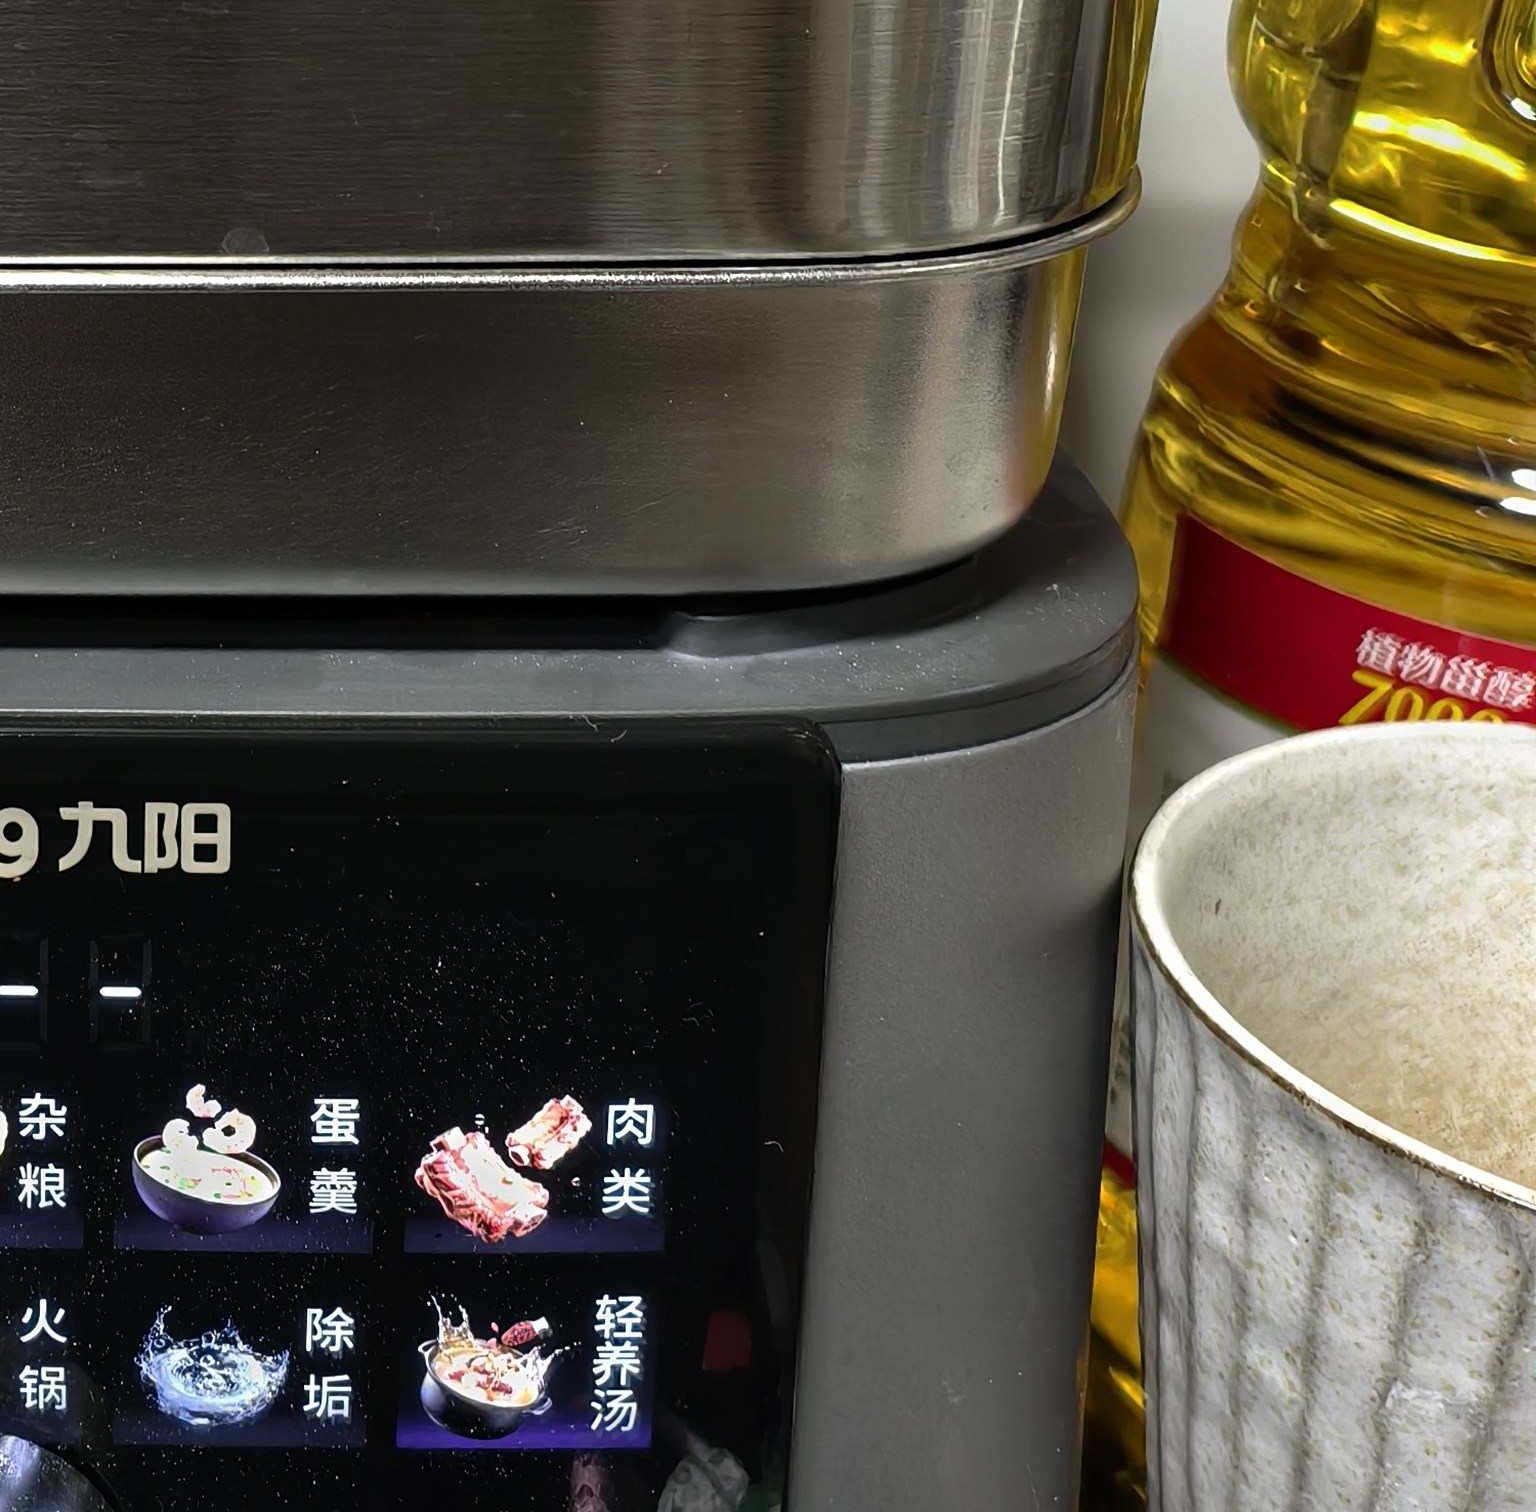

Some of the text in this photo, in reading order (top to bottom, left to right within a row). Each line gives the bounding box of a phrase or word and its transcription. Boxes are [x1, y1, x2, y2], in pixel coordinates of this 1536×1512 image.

[58, 800, 232, 874] 九阳
[17, 1091, 69, 1210] 杂粮
[308, 1097, 361, 1216] 蛋羹
[601, 1096, 656, 1216] 肉类
[18, 1297, 69, 1414] 火锅
[302, 1306, 356, 1419] 除垢
[590, 1292, 645, 1433] 轻养汤
